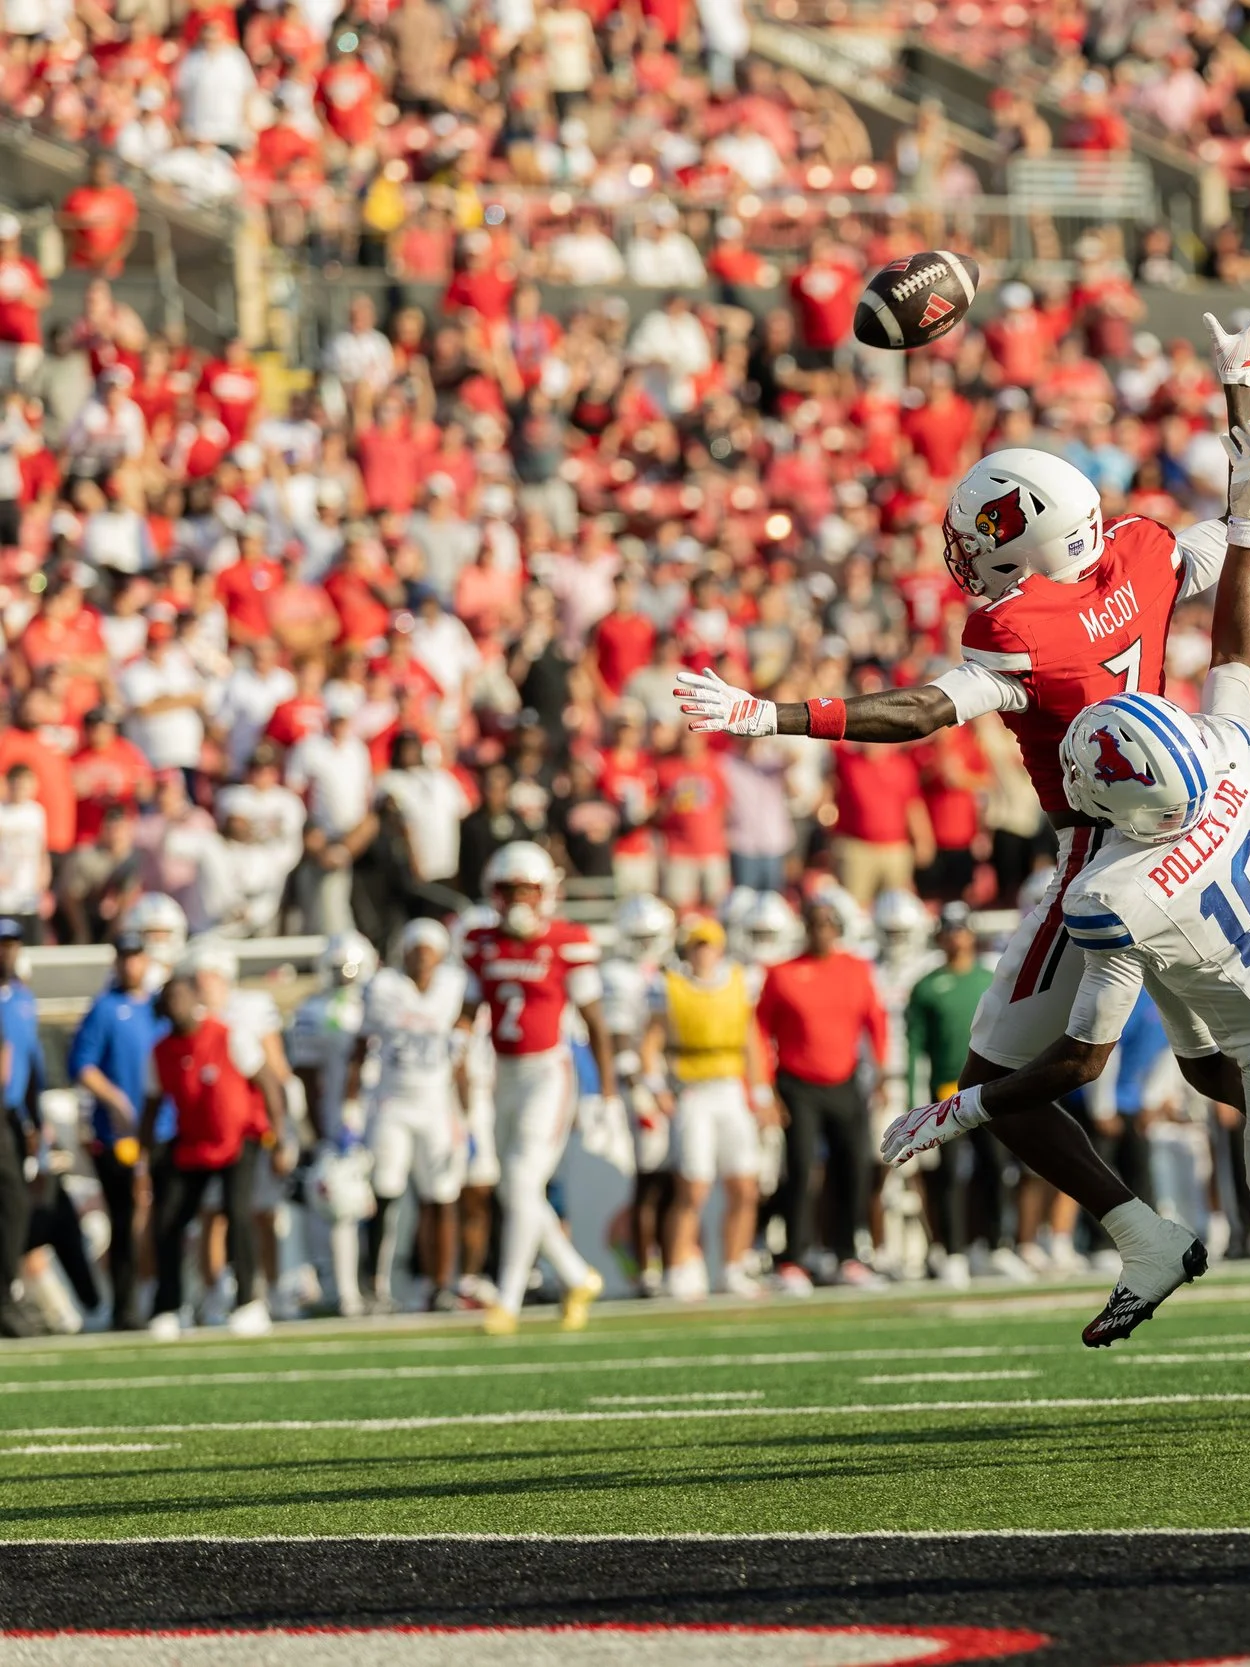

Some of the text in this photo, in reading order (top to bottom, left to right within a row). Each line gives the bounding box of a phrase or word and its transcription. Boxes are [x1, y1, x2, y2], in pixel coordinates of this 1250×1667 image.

[1098, 635, 1143, 693] 7
[1147, 810, 1231, 898] POLLEY
[1213, 779, 1249, 819] JR.
[496, 981, 525, 1041] 2
